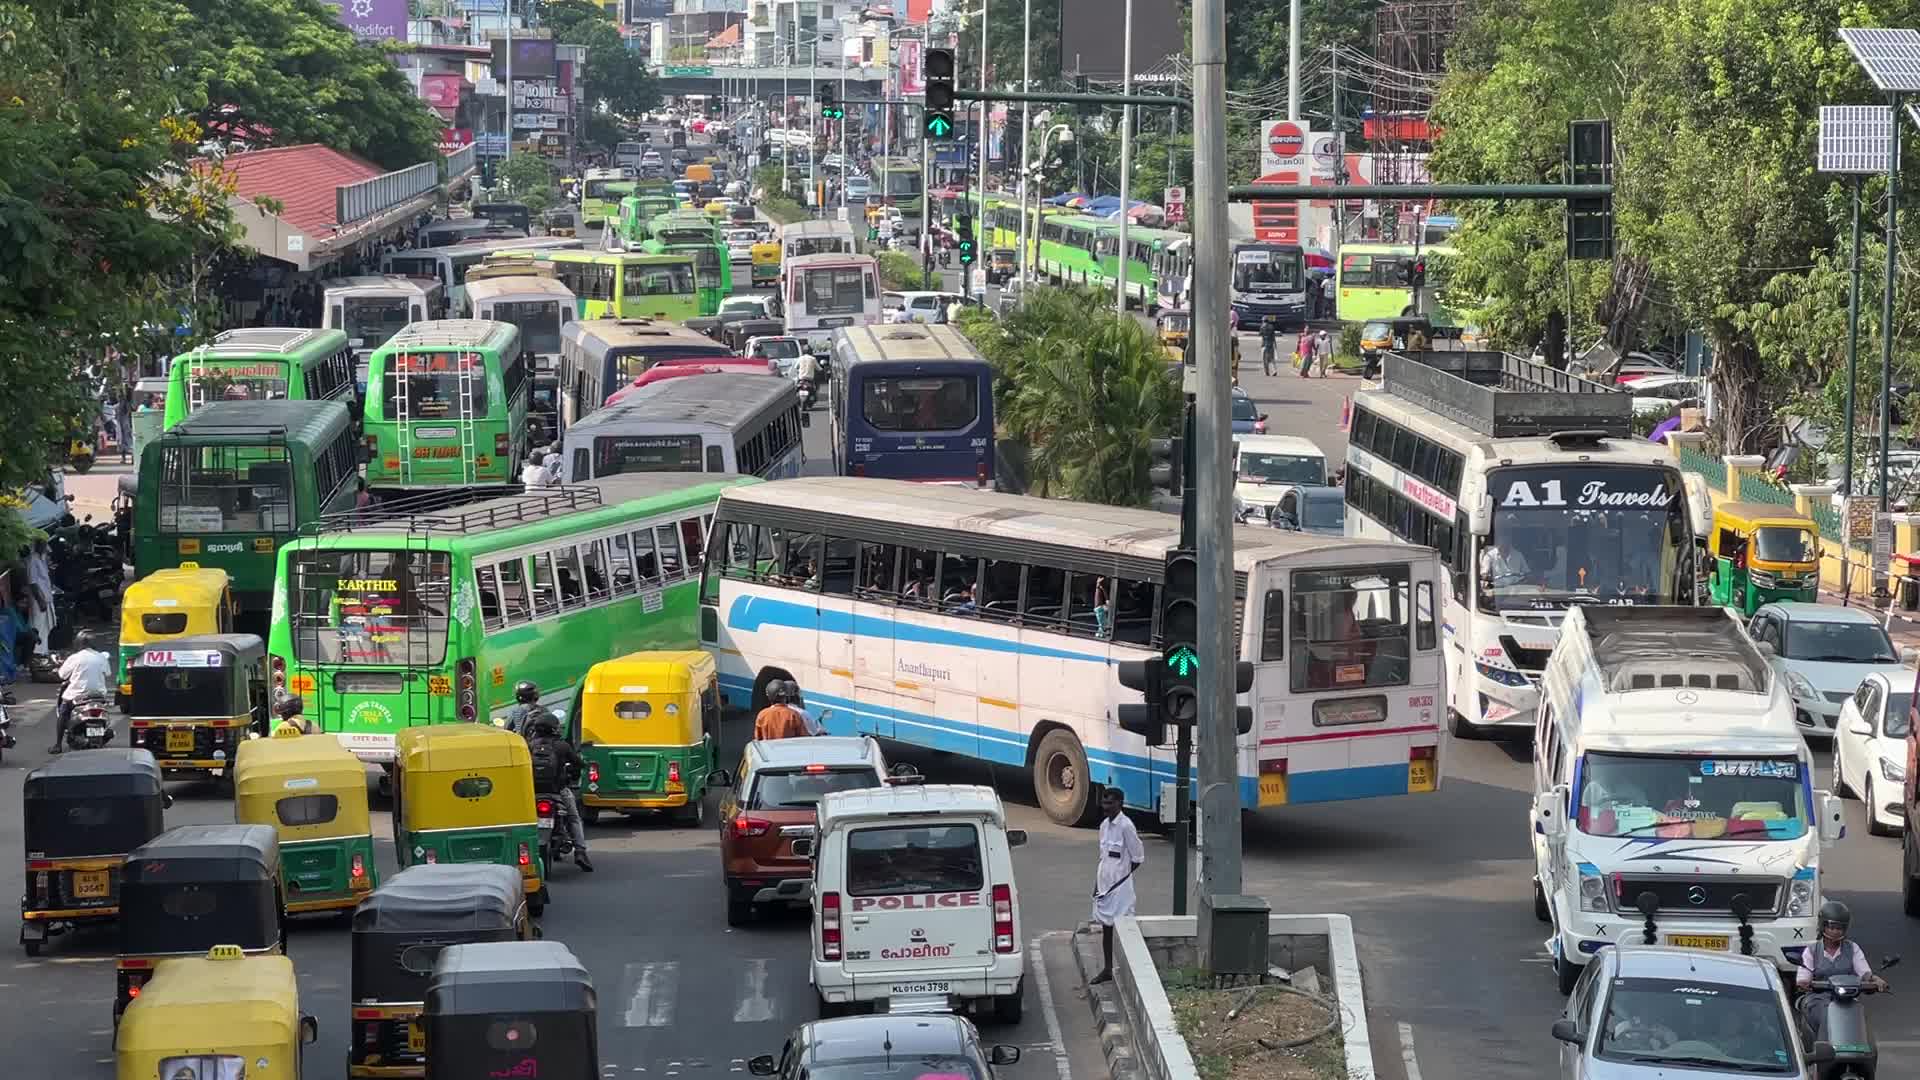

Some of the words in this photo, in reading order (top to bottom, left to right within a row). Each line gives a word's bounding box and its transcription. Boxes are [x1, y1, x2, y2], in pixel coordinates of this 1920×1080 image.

[1500, 480, 1567, 507] A1
[1577, 480, 1675, 507] Travels
[337, 579, 397, 592] KARTHIK
[896, 658, 952, 682] Ananthapuri
[851, 893, 980, 912] POLICE
[213, 947, 238, 956] TAXI
[881, 943, 955, 959] പോലീസ്
[927, 982, 949, 992] 3798
